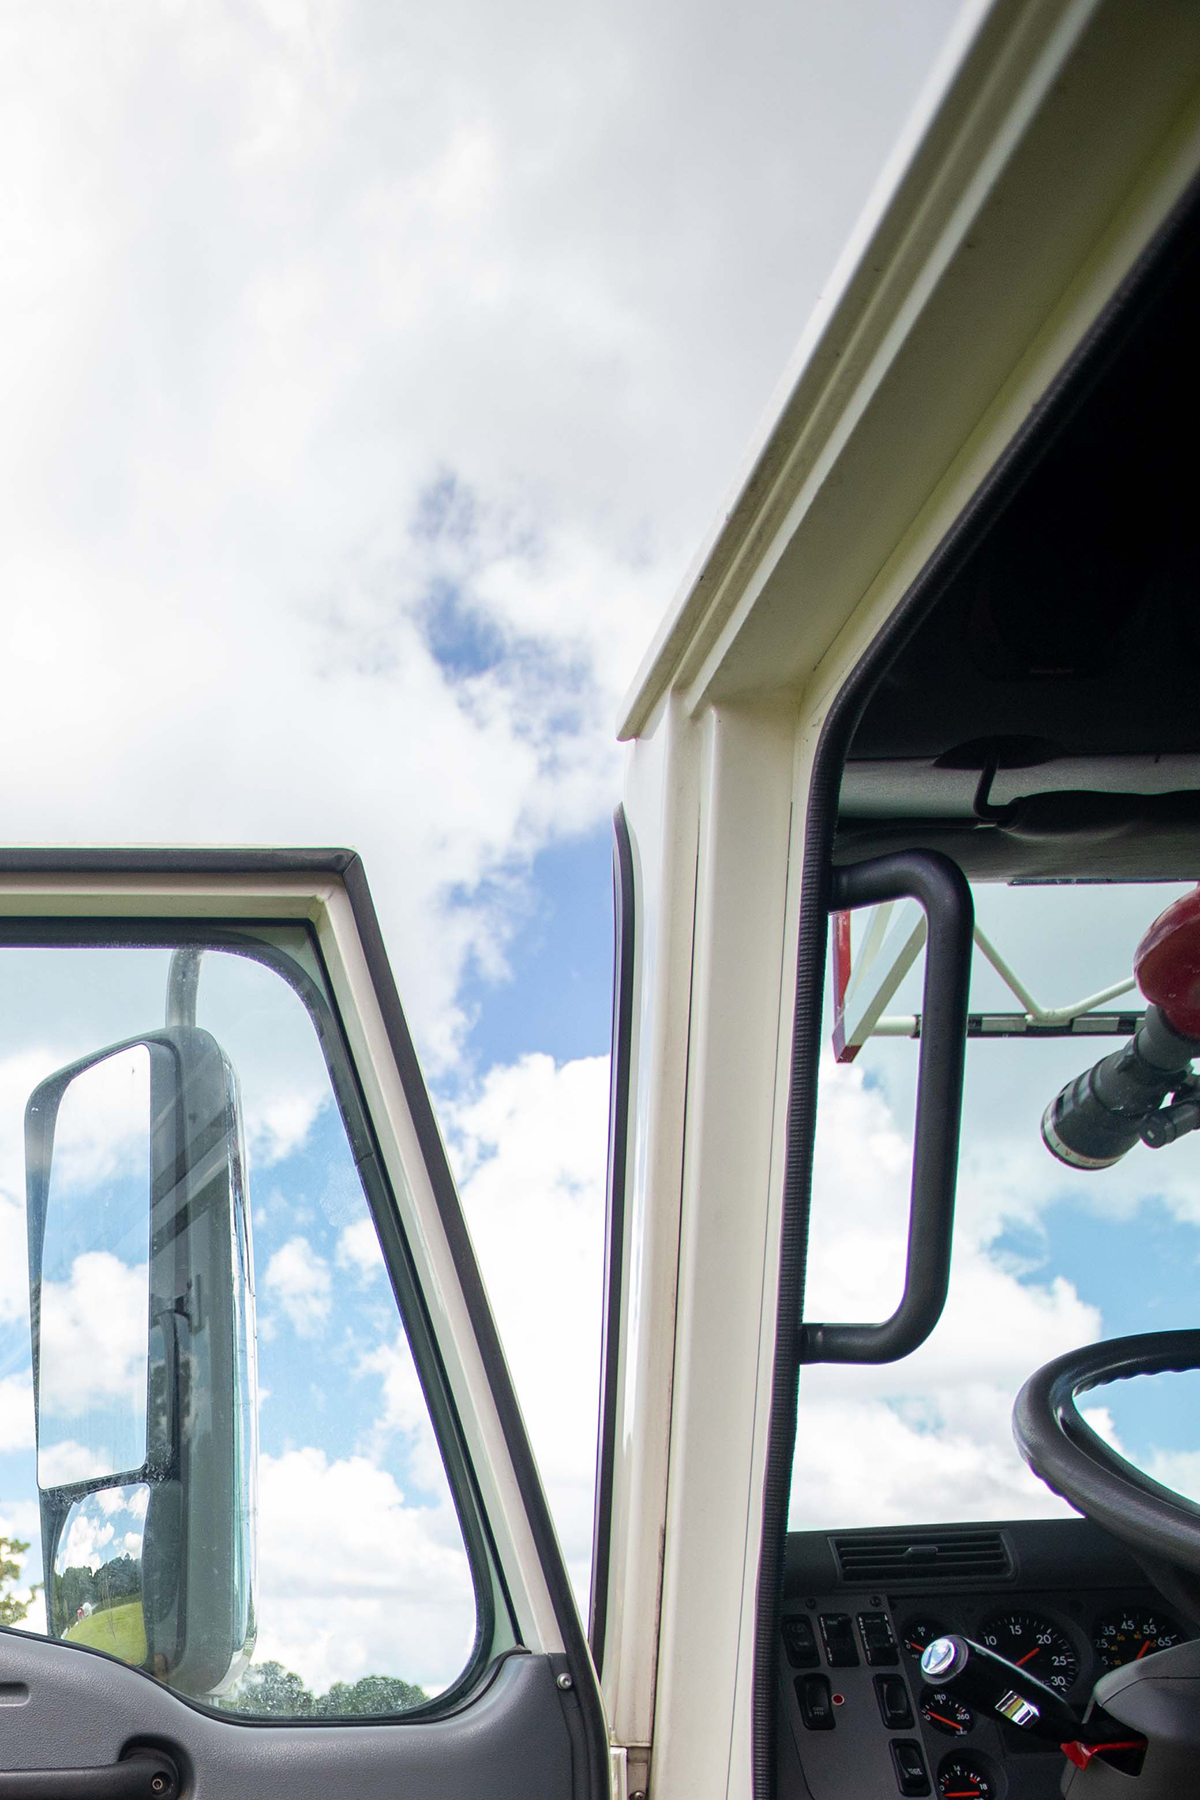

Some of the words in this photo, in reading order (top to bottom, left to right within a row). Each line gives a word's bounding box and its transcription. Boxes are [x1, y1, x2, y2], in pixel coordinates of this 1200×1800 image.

[1009, 1625, 1022, 1635] 15
[1121, 1620, 1135, 1630] 45
[1143, 1624, 1157, 1634] 55
[1102, 1625, 1116, 1636] 35
[984, 1636, 997, 1646] 10
[1036, 1634, 1051, 1645] 20
[1095, 1638, 1108, 1648] 25
[1157, 1636, 1172, 1647] 65
[1051, 1656, 1067, 1666] 25
[1051, 1676, 1066, 1686] 30
